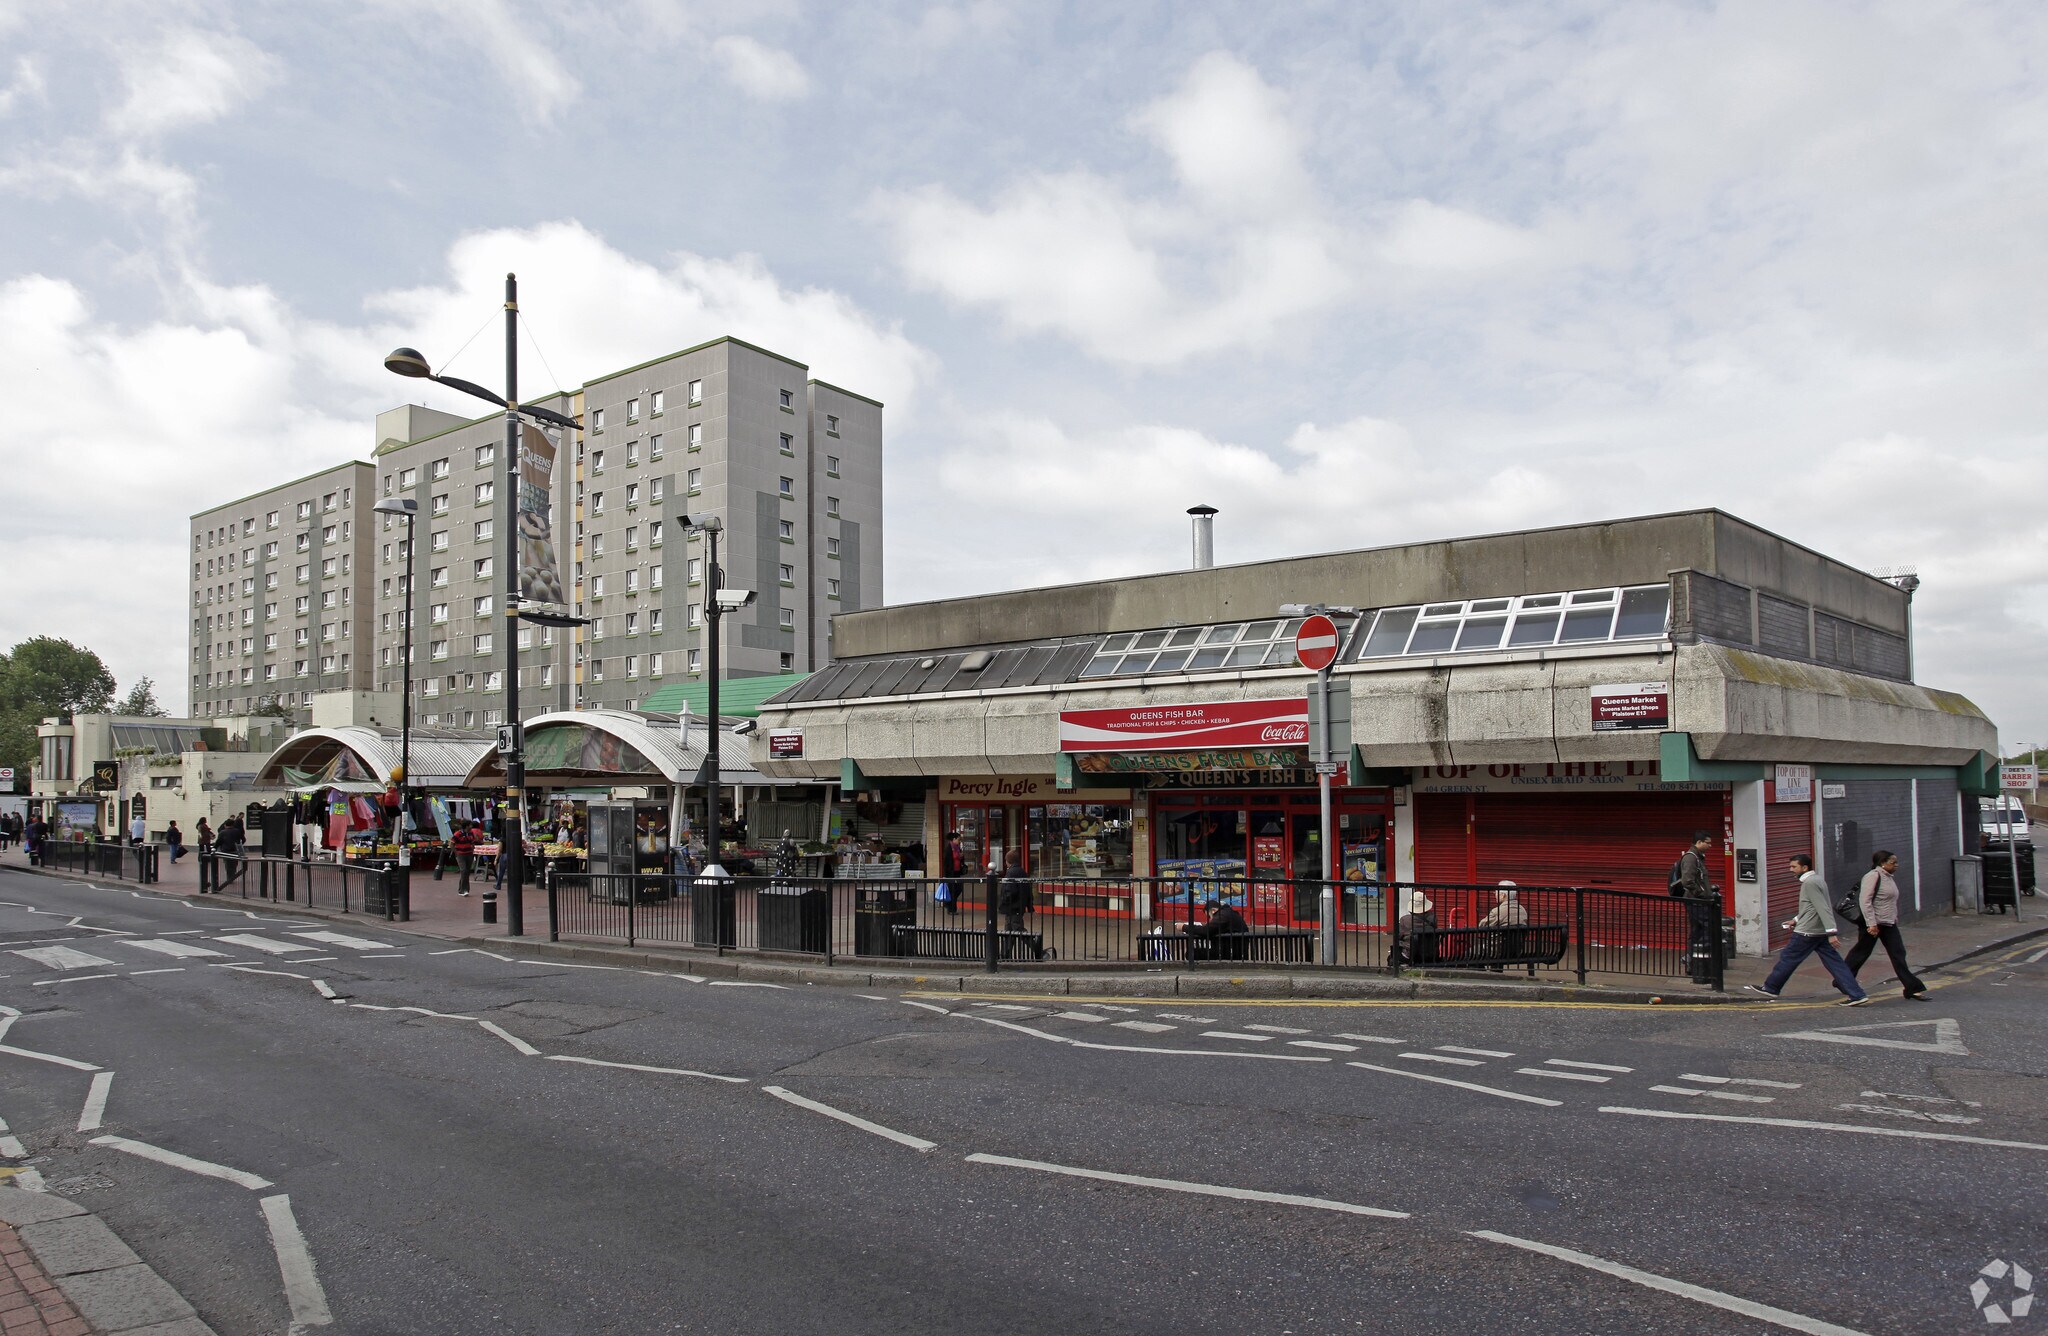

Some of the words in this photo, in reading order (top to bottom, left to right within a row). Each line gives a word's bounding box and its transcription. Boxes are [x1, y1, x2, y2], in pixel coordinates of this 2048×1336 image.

[522, 446, 551, 468] QUEENS
[1130, 711, 1163, 720] QUEENS
[1165, 710, 1184, 719] FISH
[1186, 709, 1204, 718] BAR
[1108, 754, 1192, 770] QUEENS
[1200, 752, 1246, 768] FISH
[1252, 750, 1298, 767] BAR
[1421, 764, 1477, 779] TOP
[1487, 763, 1526, 778] OF
[1624, 760, 1659, 776] LI
[1777, 766, 1788, 777] TOP
[1788, 766, 1797, 777] OF
[1798, 767, 1808, 777] THE
[1179, 769, 1251, 787] QUEEN'S
[1259, 769, 1296, 784] FISH
[1510, 776, 1548, 785] UNISEX
[1551, 775, 1584, 785] BRAID
[1589, 775, 1625, 784] SALON
[1787, 778, 1801, 788] LINE
[948, 779, 994, 797] Percy
[996, 778, 1038, 797] Ingle
[1424, 785, 1438, 793] 404
[1440, 785, 1473, 793] GREEN
[1678, 782, 1699, 790] 8471
[1703, 782, 1724, 791] 1400
[1137, 821, 1145, 830] H
